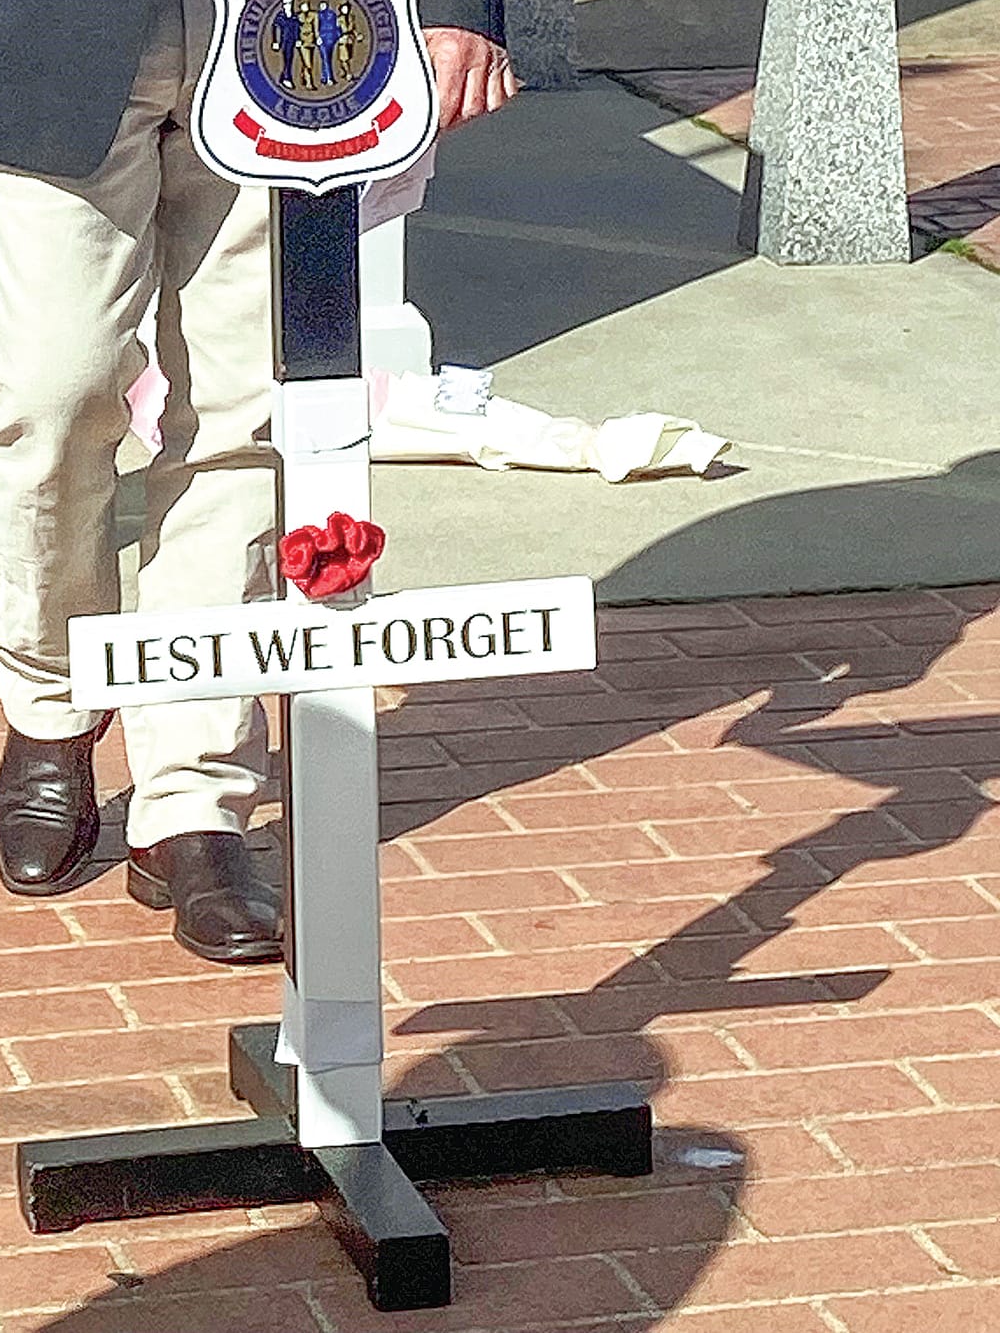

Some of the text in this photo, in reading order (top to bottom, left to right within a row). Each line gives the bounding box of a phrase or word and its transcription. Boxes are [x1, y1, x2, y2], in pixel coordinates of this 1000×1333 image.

[104, 607, 561, 687] LEST WE FORGET
